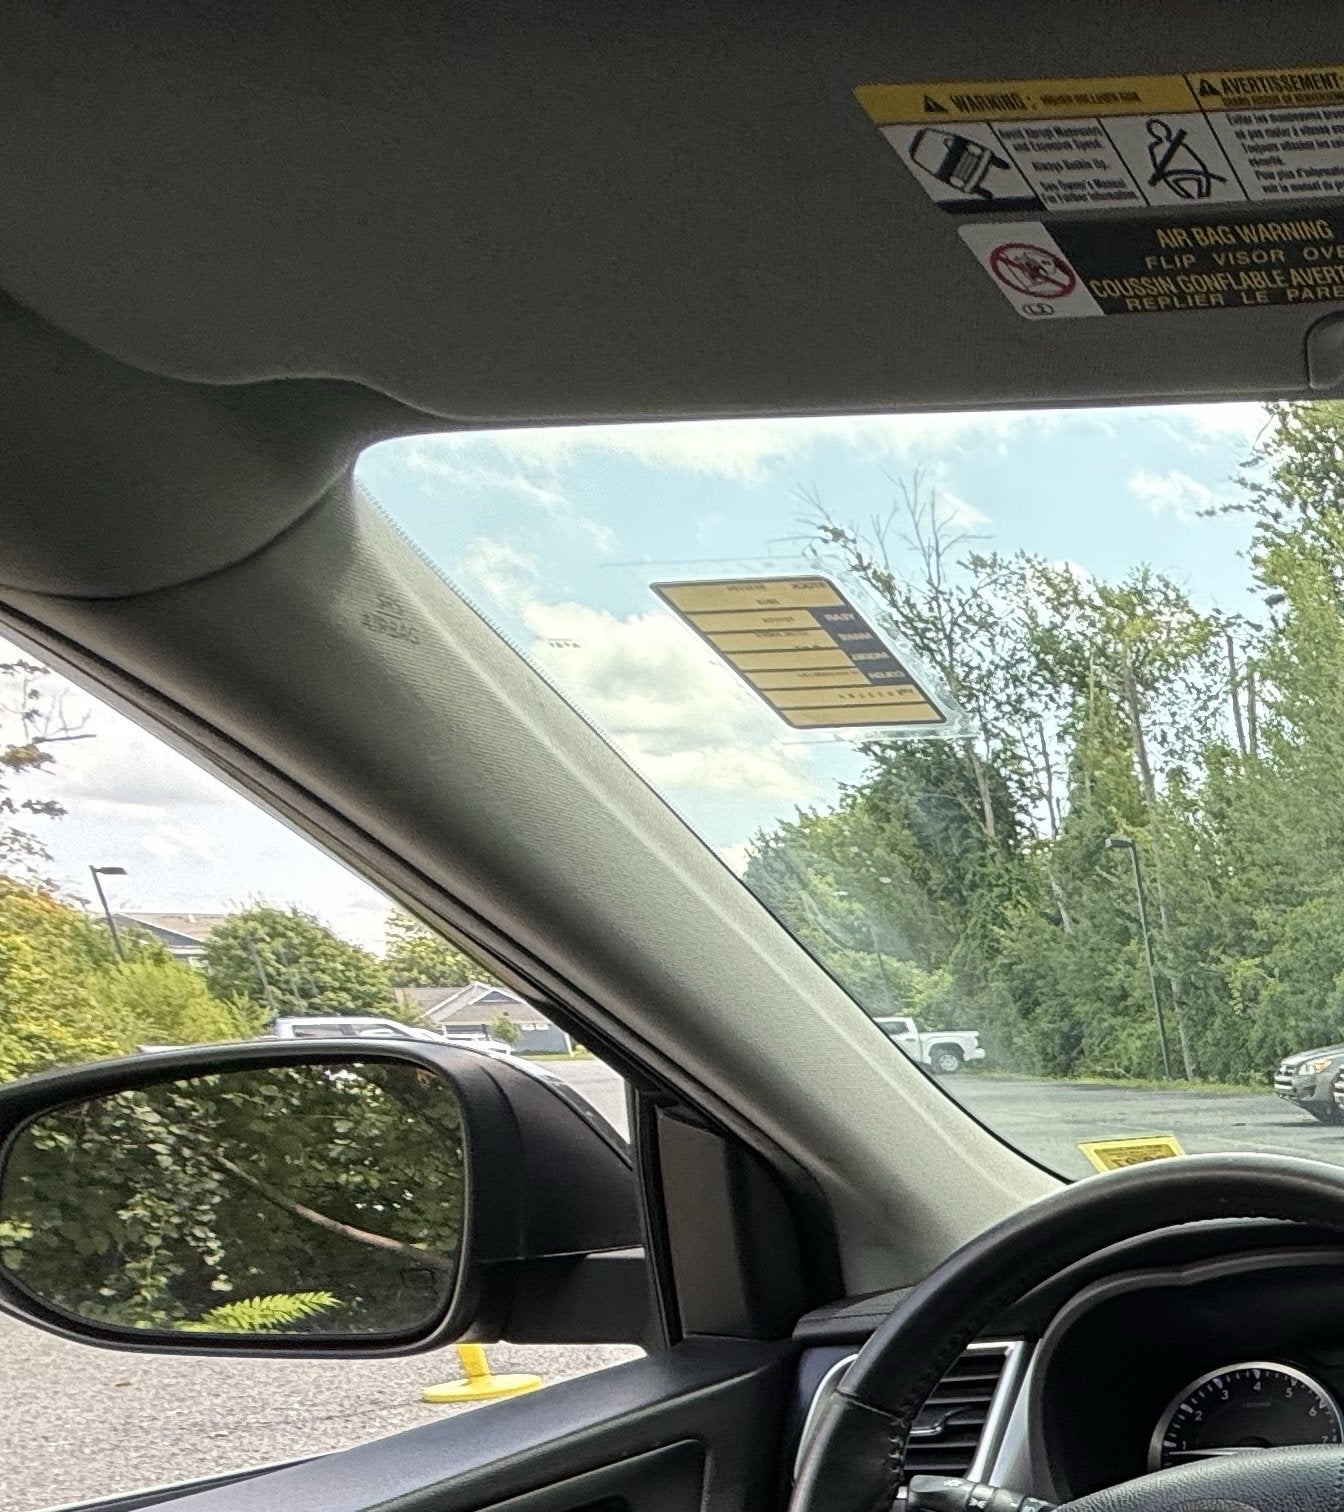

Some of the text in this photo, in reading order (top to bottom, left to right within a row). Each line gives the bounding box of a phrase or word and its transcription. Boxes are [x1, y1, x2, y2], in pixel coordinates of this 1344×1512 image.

[1156, 219, 1334, 249] AIR BAG WARNING
[1145, 253, 1197, 271] FLIP
[1213, 249, 1285, 267] VISOR
[1089, 274, 1176, 298] COUSSIN
[1126, 292, 1226, 312] REPLIER
[1244, 289, 1269, 305] LE
[1253, 1382, 1262, 1391] 4
[1221, 1389, 1229, 1400] 3
[1285, 1387, 1293, 1398] 5
[1195, 1410, 1203, 1421] 2
[1309, 1408, 1317, 1417] 6
